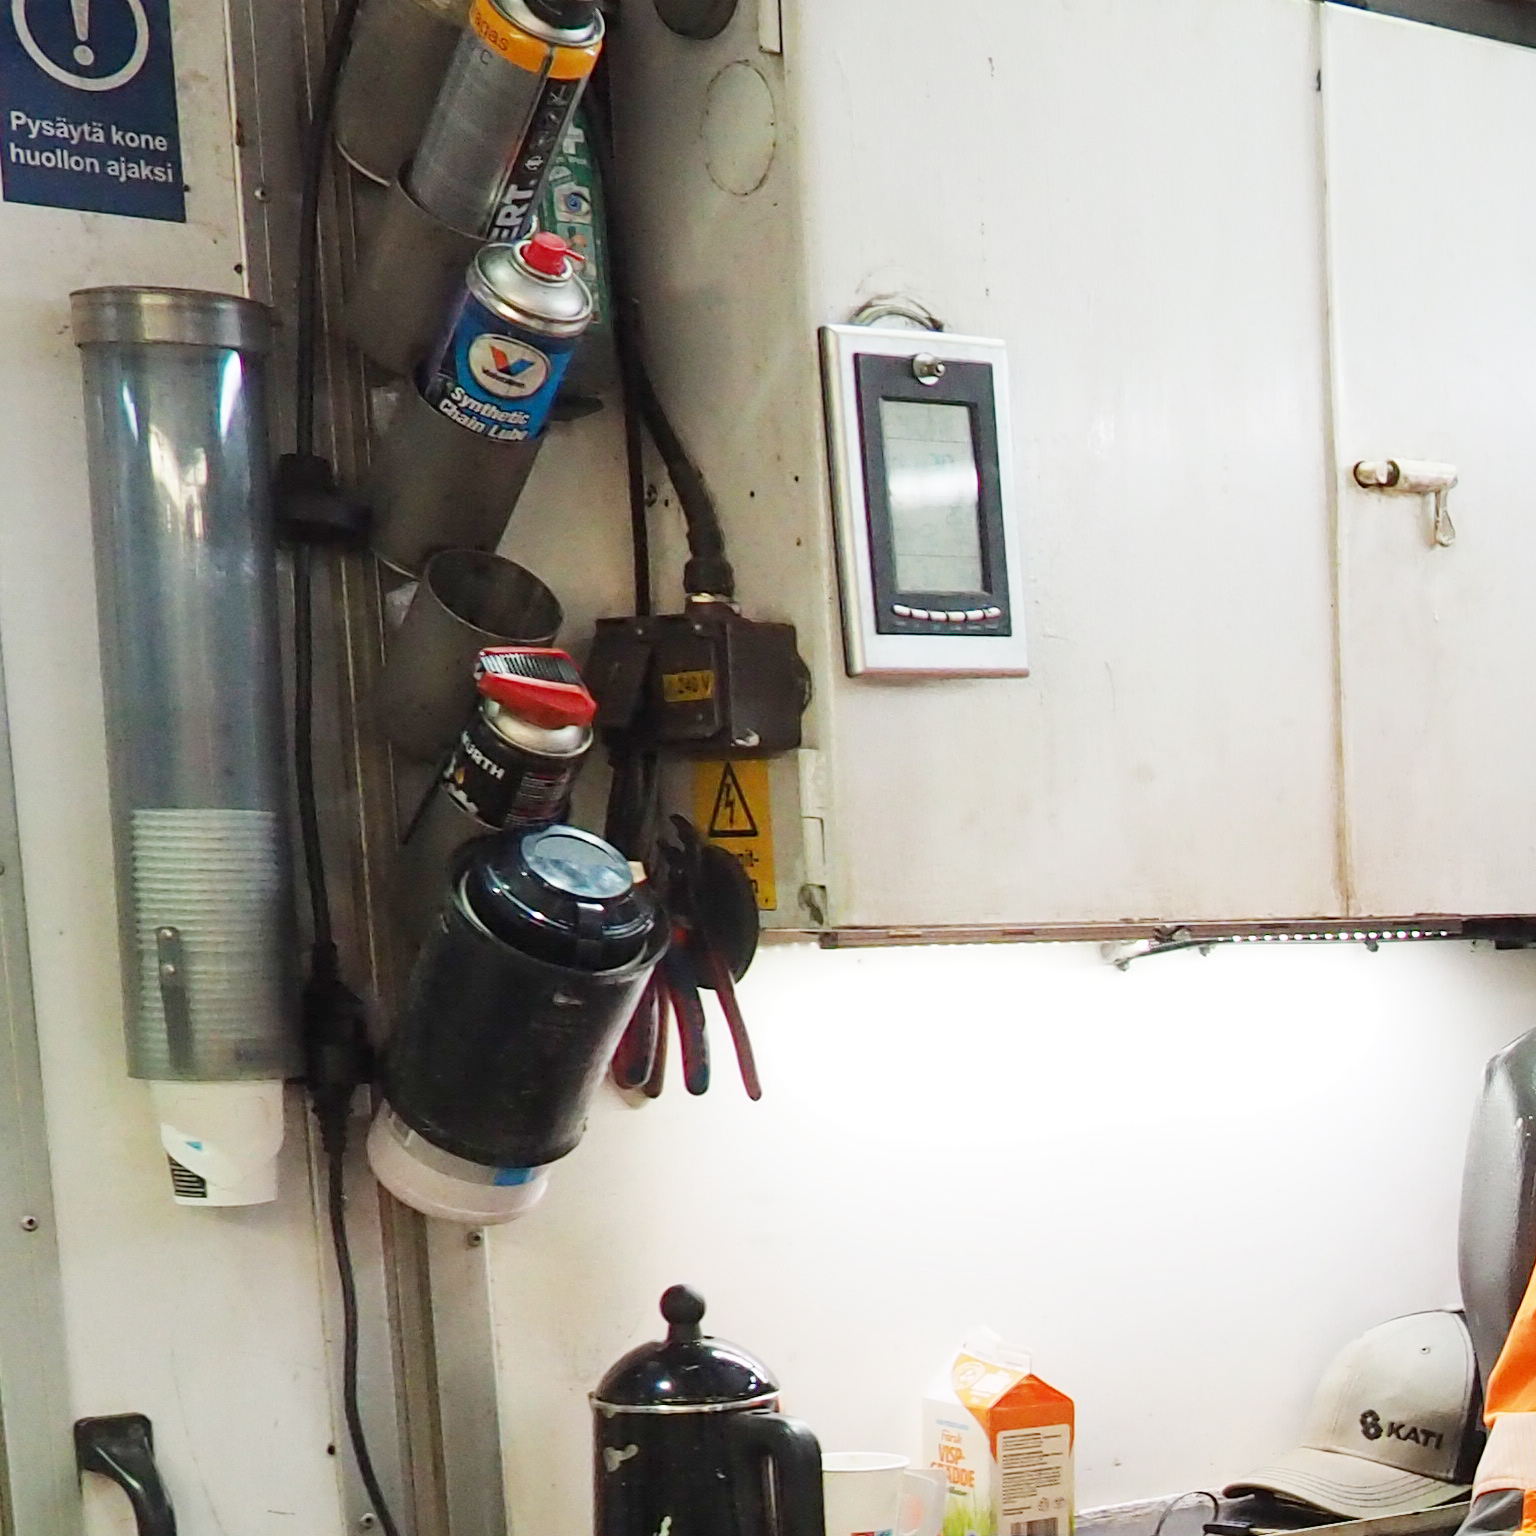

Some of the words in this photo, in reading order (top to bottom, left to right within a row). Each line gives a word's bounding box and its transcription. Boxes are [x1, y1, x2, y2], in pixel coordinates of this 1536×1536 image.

[9, 110, 104, 145] Pysäytä
[111, 124, 168, 152] kone
[9, 142, 100, 174] huollon
[106, 156, 174, 183] ajaksi
[438, 398, 487, 433] Chain
[450, 386, 531, 426] Synthetic
[1386, 1422, 1444, 1450] KATI
